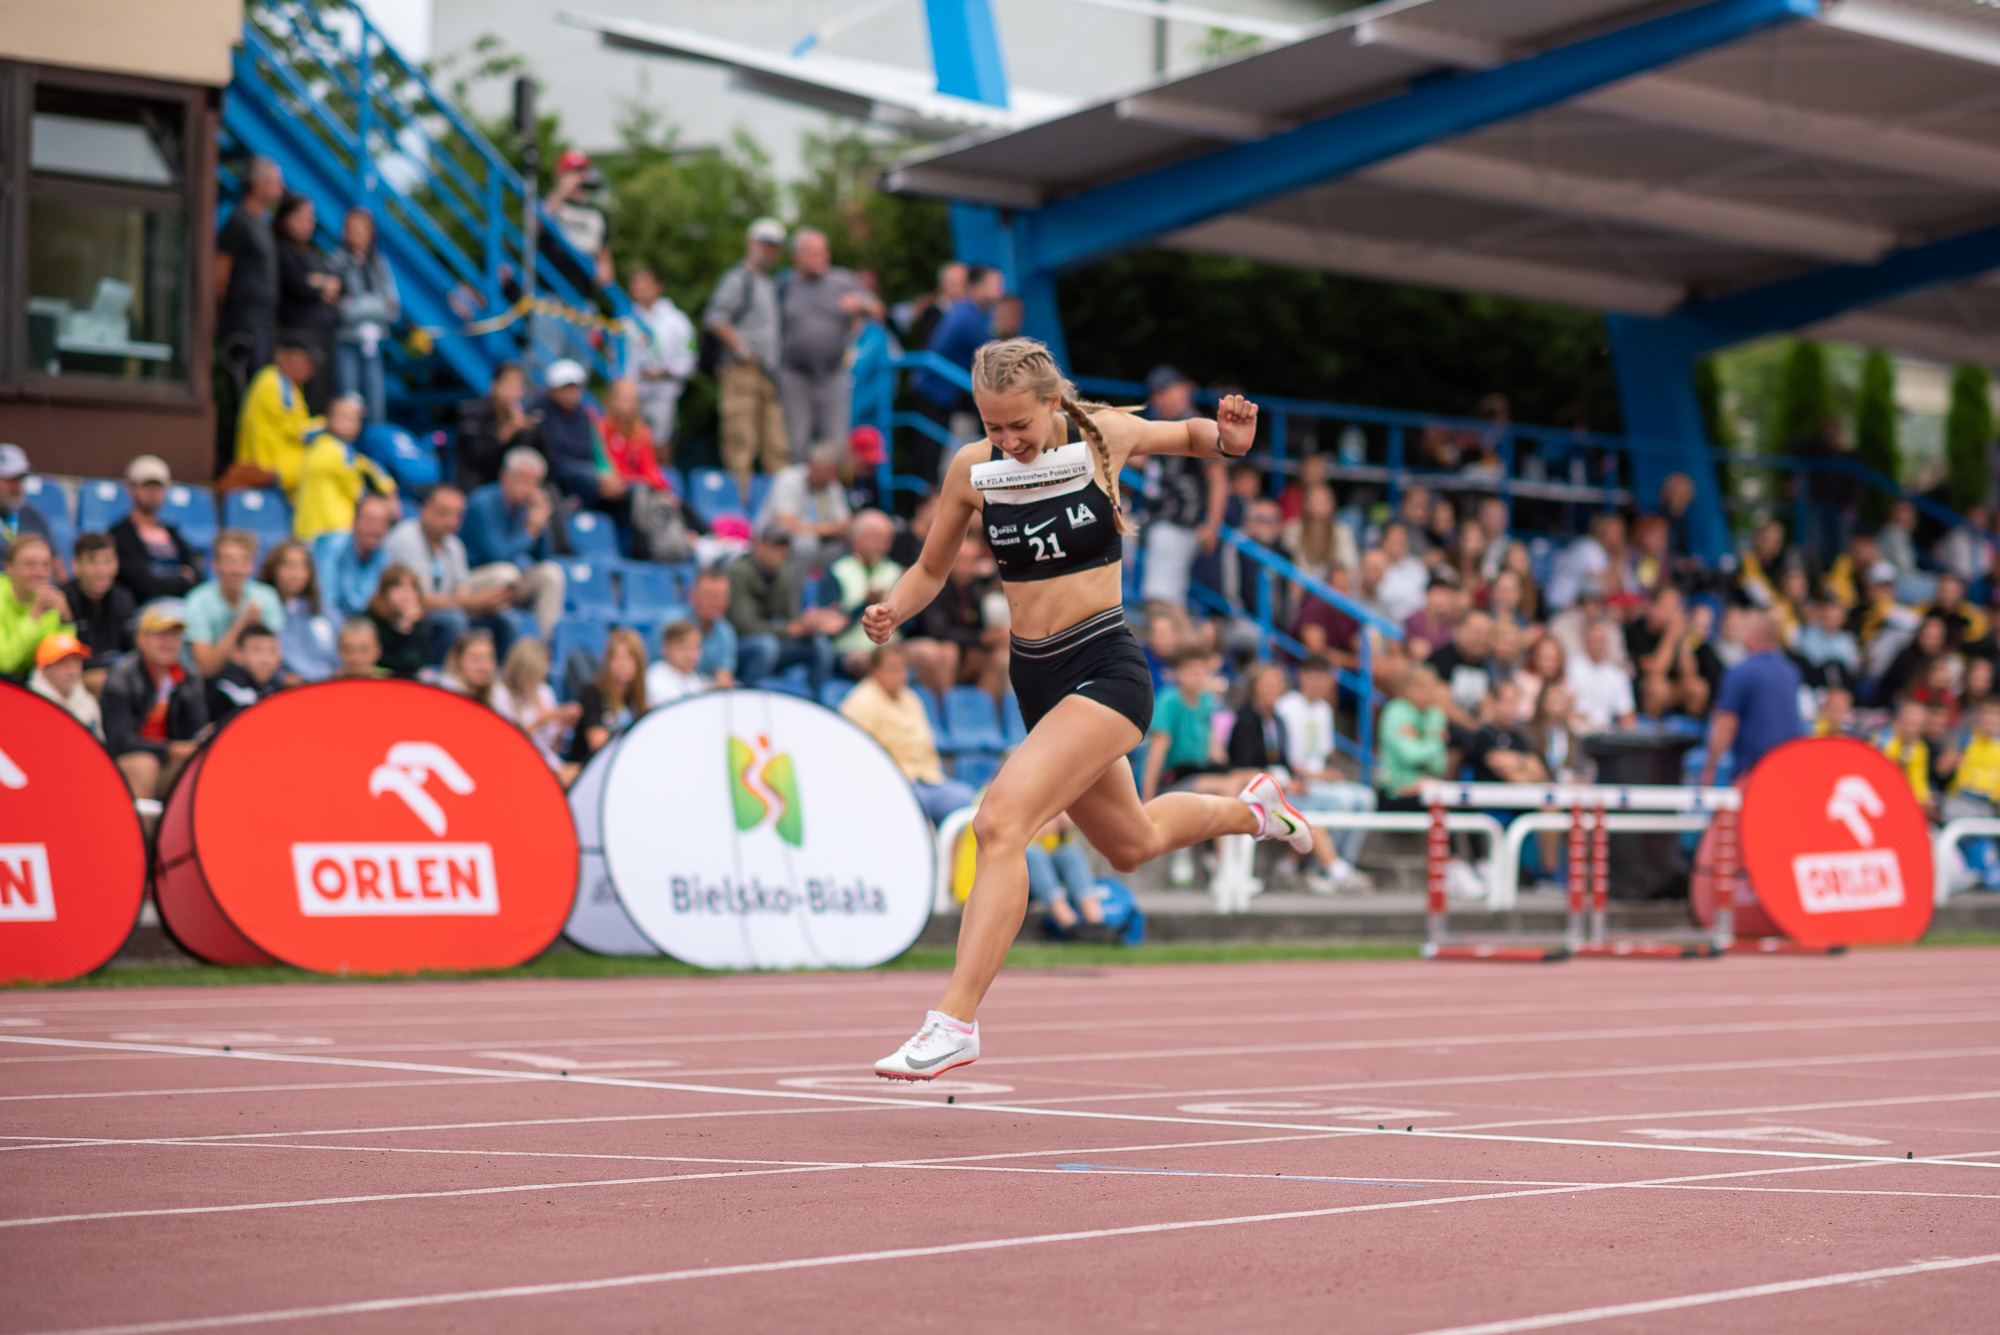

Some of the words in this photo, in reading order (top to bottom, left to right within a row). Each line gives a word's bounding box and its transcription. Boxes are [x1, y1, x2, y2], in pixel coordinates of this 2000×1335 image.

[987, 477, 1004, 485] PZLA
[1006, 472, 1048, 482] Mistrzostwa
[1049, 468, 1071, 477] Polski
[1072, 465, 1087, 473] U18
[998, 526, 1017, 534] OPOLE
[1028, 532, 1067, 561] 21
[312, 858, 480, 901] ORLEN
[671, 875, 887, 914] Bielsko-Biała
